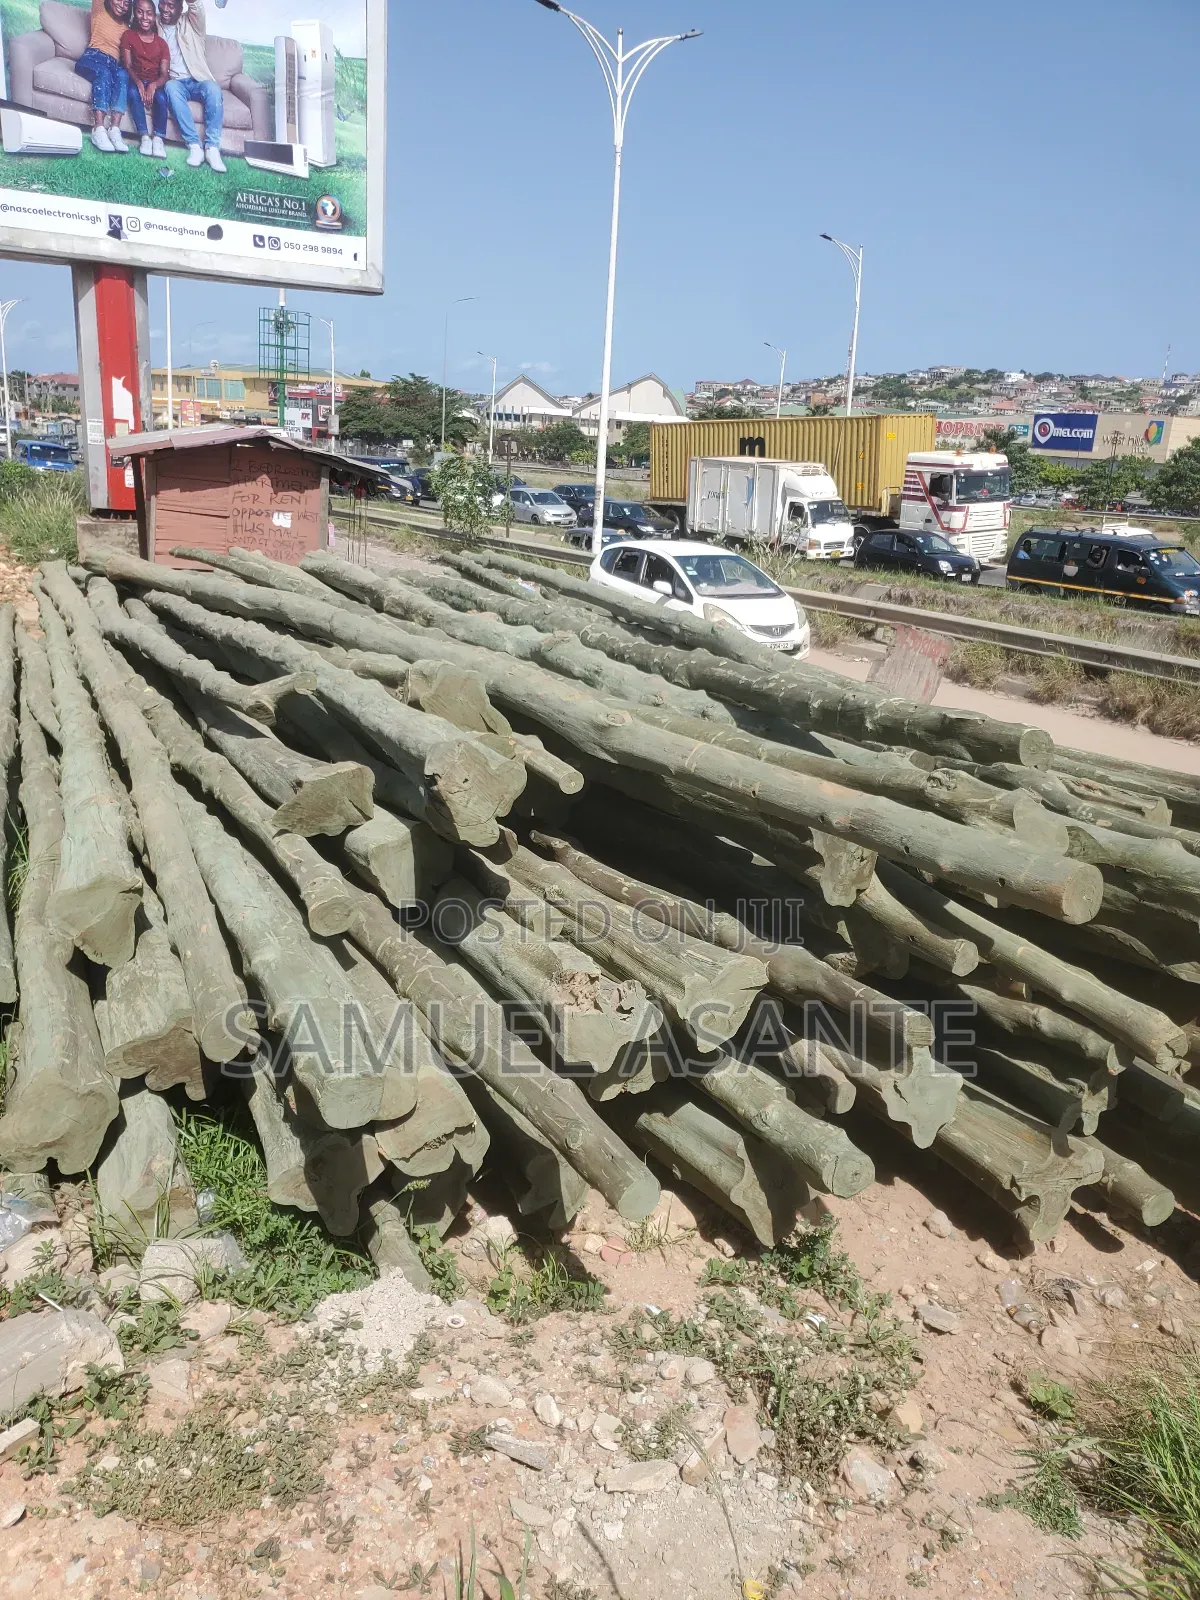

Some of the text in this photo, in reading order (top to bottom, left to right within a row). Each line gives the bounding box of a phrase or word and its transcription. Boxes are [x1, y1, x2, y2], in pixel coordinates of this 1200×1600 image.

[236, 192, 280, 207] AFRICA'S
[0, 203, 102, 224] @nascoelectronicsgh
[143, 222, 205, 237] @nascoghana
[283, 241, 343, 256] 050 298 9894
[936, 421, 1005, 437] HOPRITE
[232, 490, 312, 505] FOR RENT
